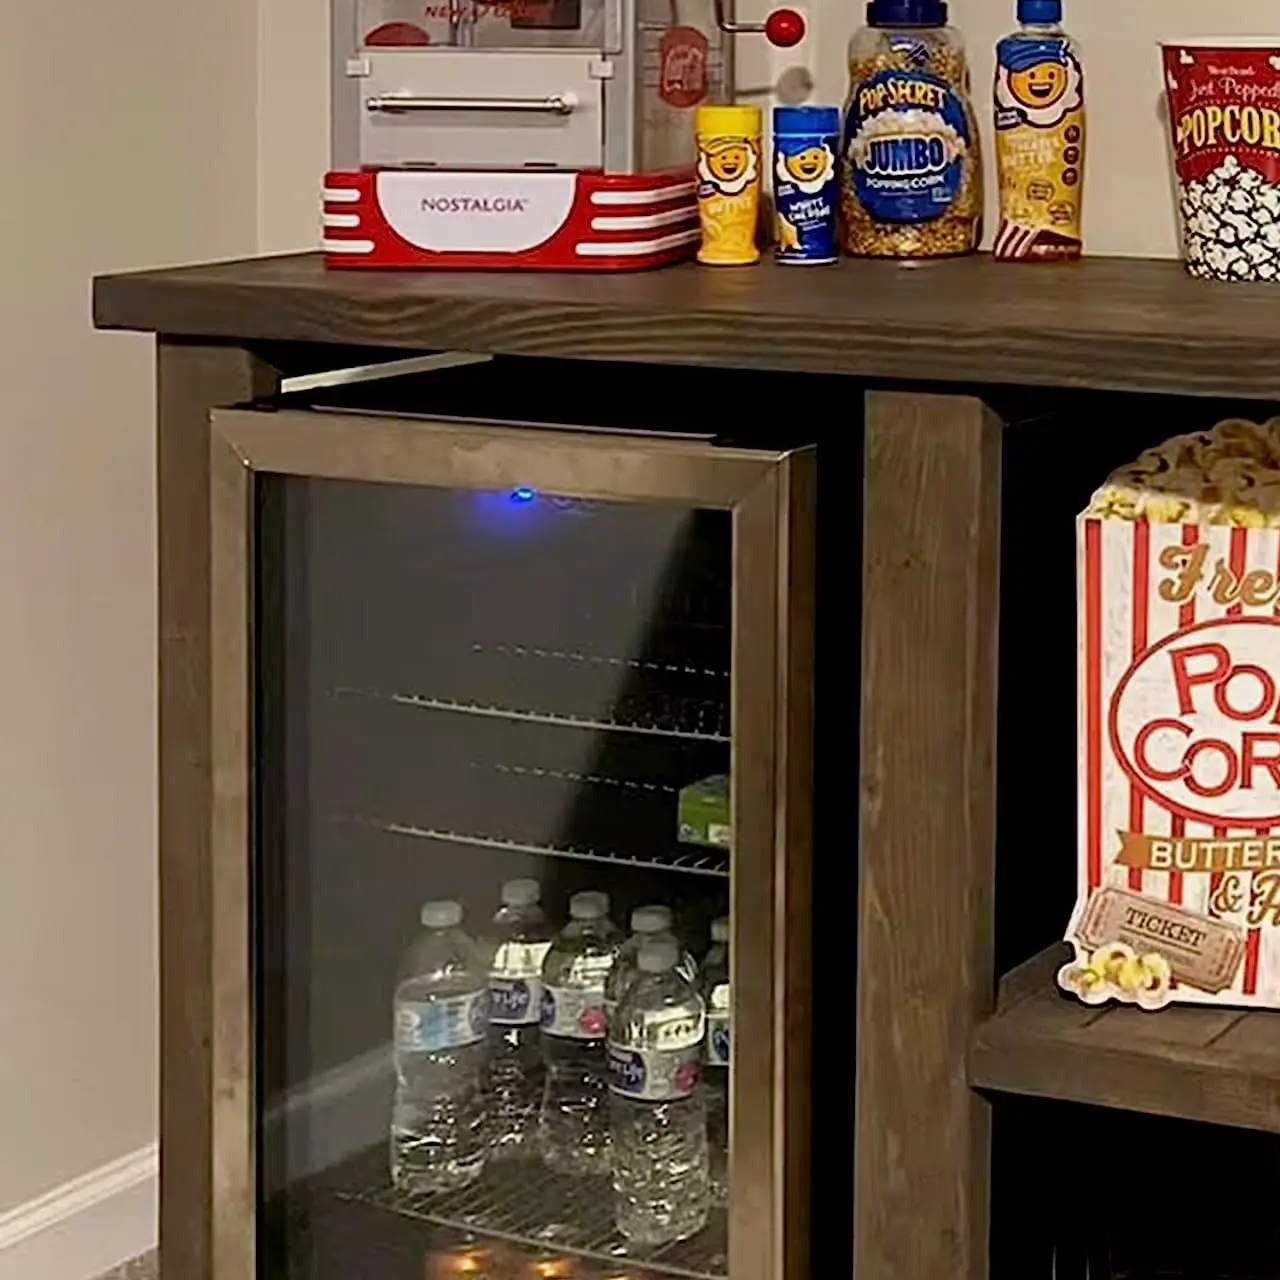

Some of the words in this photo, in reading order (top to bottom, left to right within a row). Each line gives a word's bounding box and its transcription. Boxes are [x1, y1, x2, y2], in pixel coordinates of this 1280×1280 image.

[860, 84, 887, 116] POP
[887, 77, 946, 110] SECRET
[865, 136, 946, 172] JUMBO
[1212, 874, 1243, 913] &
[1125, 906, 1207, 947] TICKET
